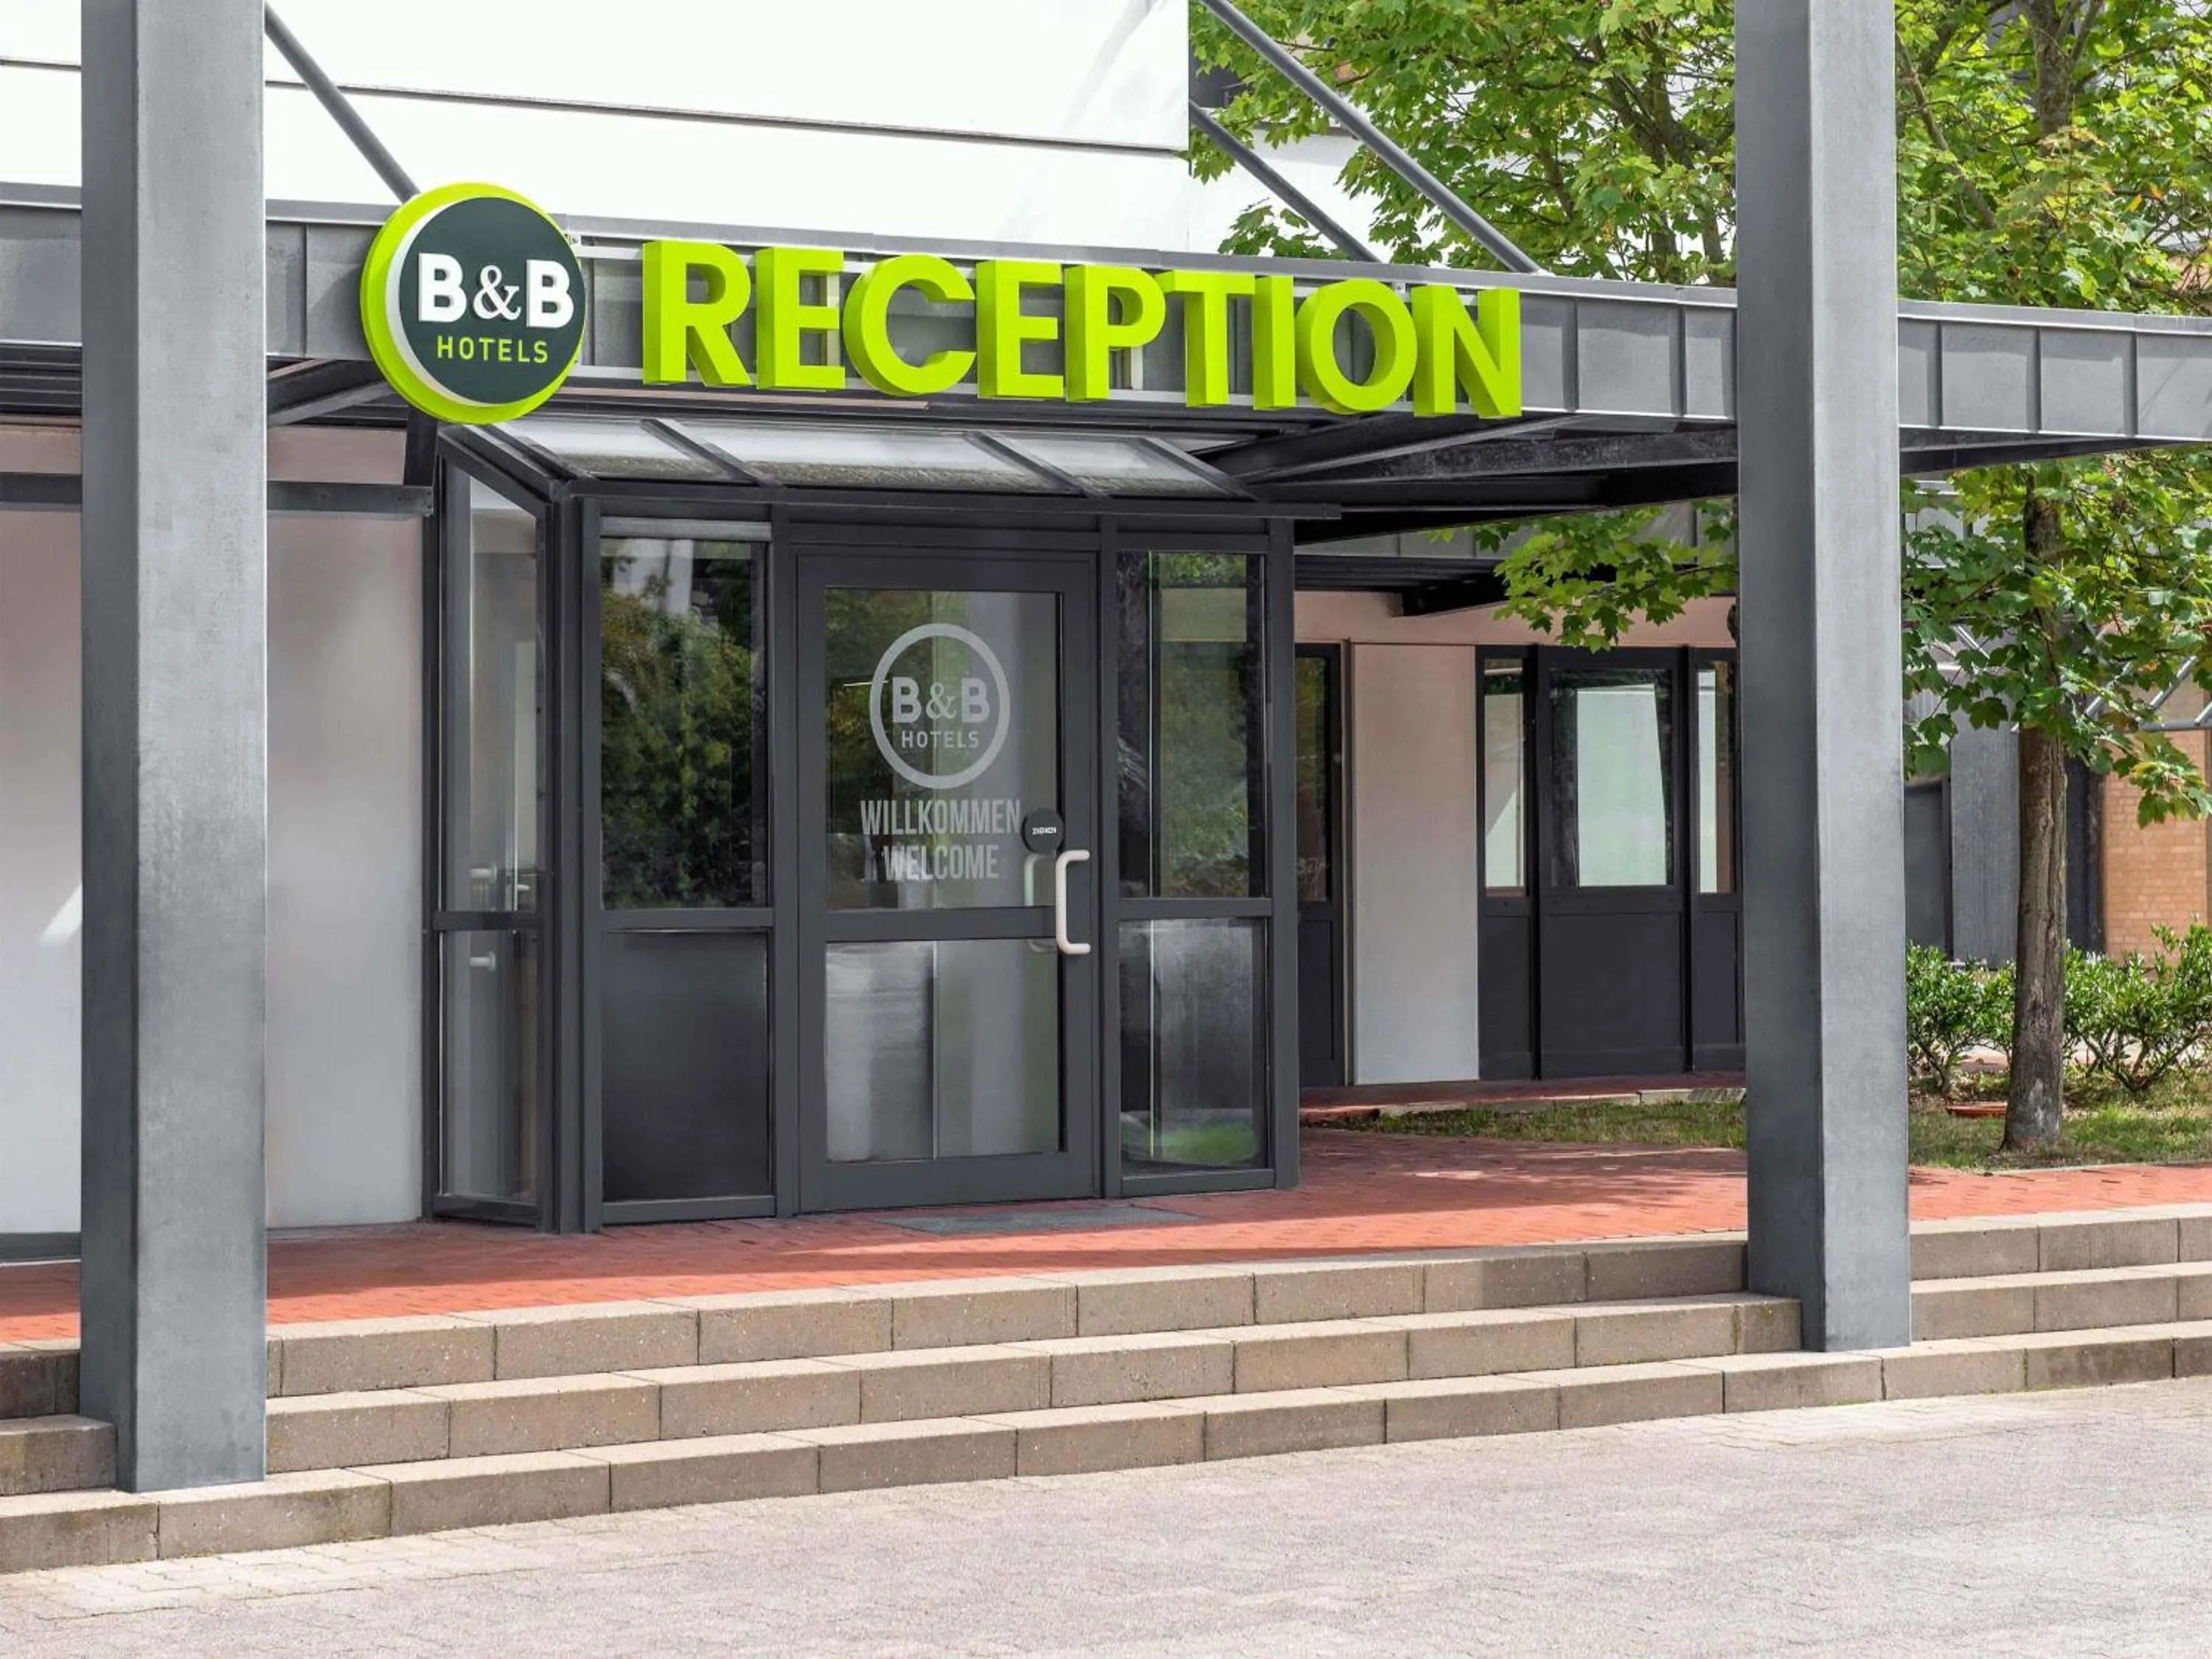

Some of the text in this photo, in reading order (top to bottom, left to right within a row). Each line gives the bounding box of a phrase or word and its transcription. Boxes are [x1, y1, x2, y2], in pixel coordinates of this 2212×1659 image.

[418, 252, 574, 329] B&B
[643, 240, 1522, 420] RECEPTION
[437, 335, 549, 364] HOTELS
[892, 676, 990, 723] B&B
[902, 731, 979, 748] HOTELS
[860, 799, 1020, 835] WILLKOMMEN
[884, 845, 999, 880] WELCOME
